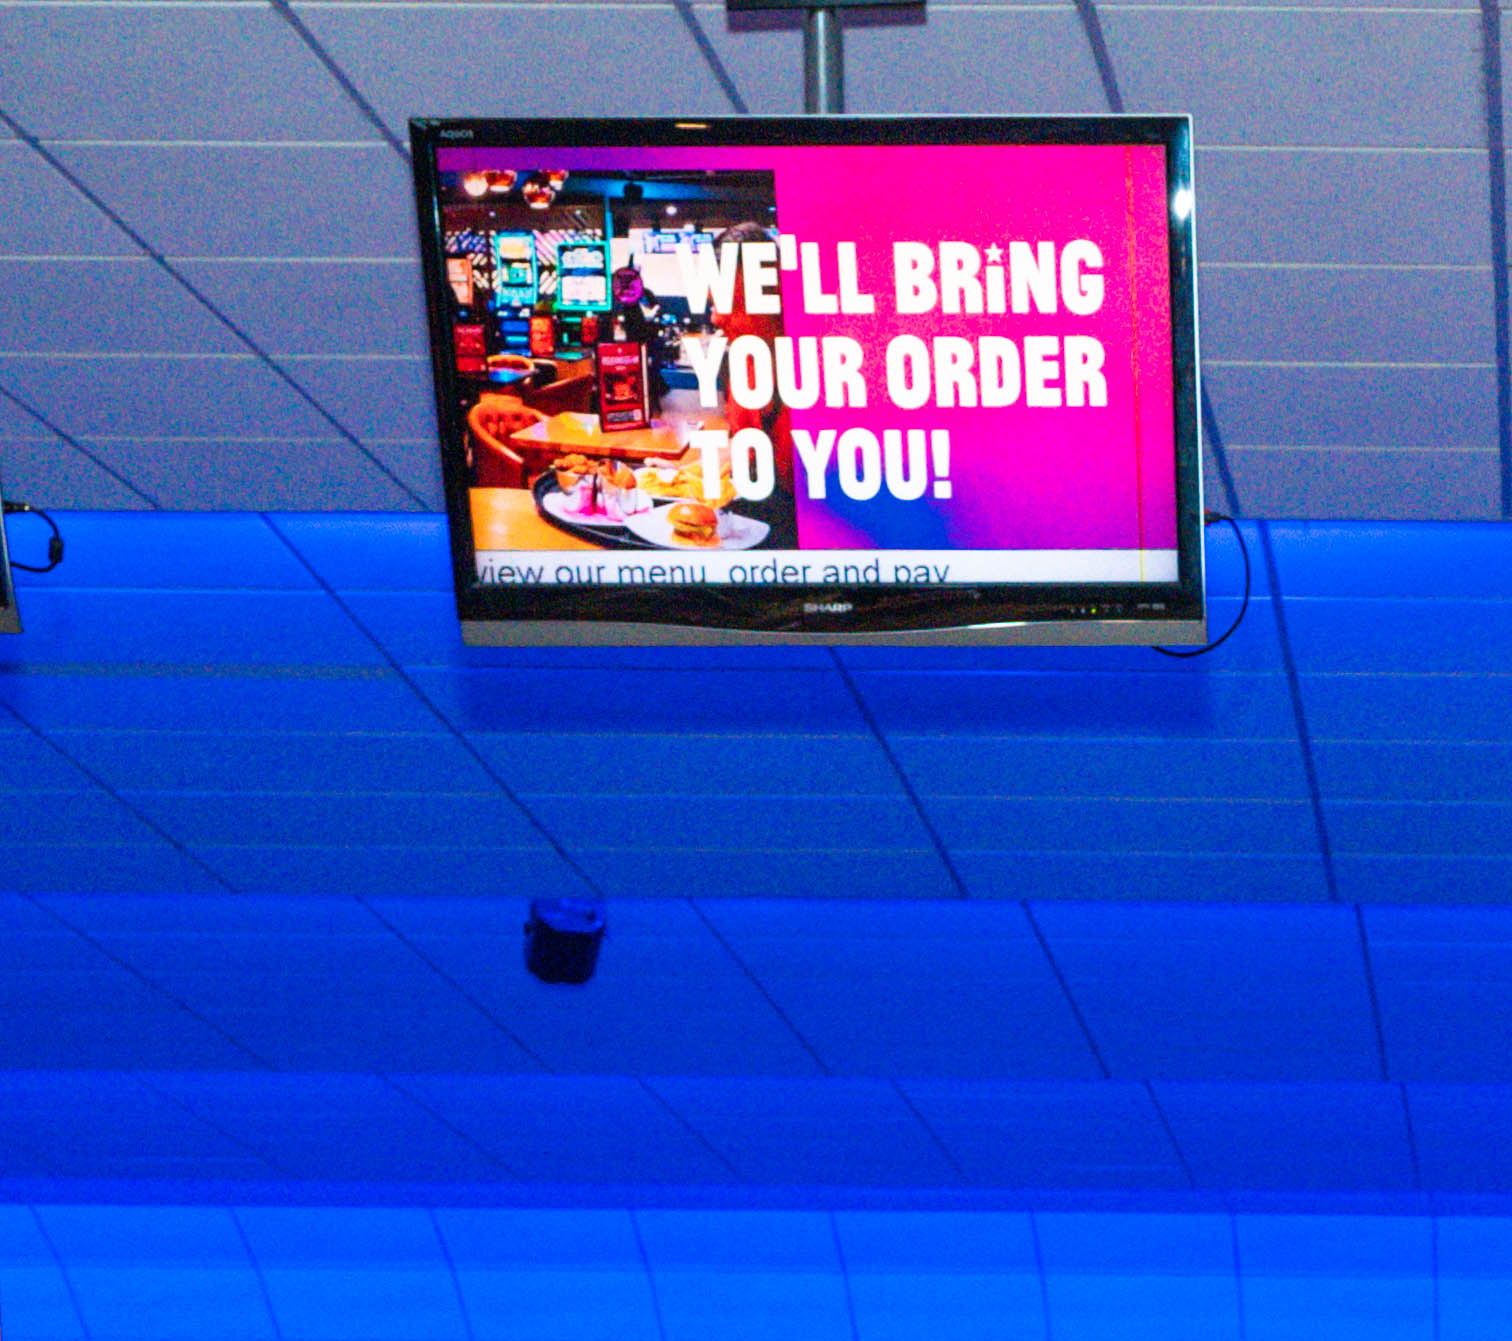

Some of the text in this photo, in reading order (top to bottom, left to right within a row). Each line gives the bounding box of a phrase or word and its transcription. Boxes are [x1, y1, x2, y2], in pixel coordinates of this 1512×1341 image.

[675, 234, 875, 315] WE'LL
[682, 335, 1109, 409] YOUR ORDER
[689, 428, 953, 501] TO YOU!
[555, 563, 606, 584] our
[728, 558, 812, 585] order
[822, 559, 880, 585] and
[803, 602, 854, 613] SHARP
